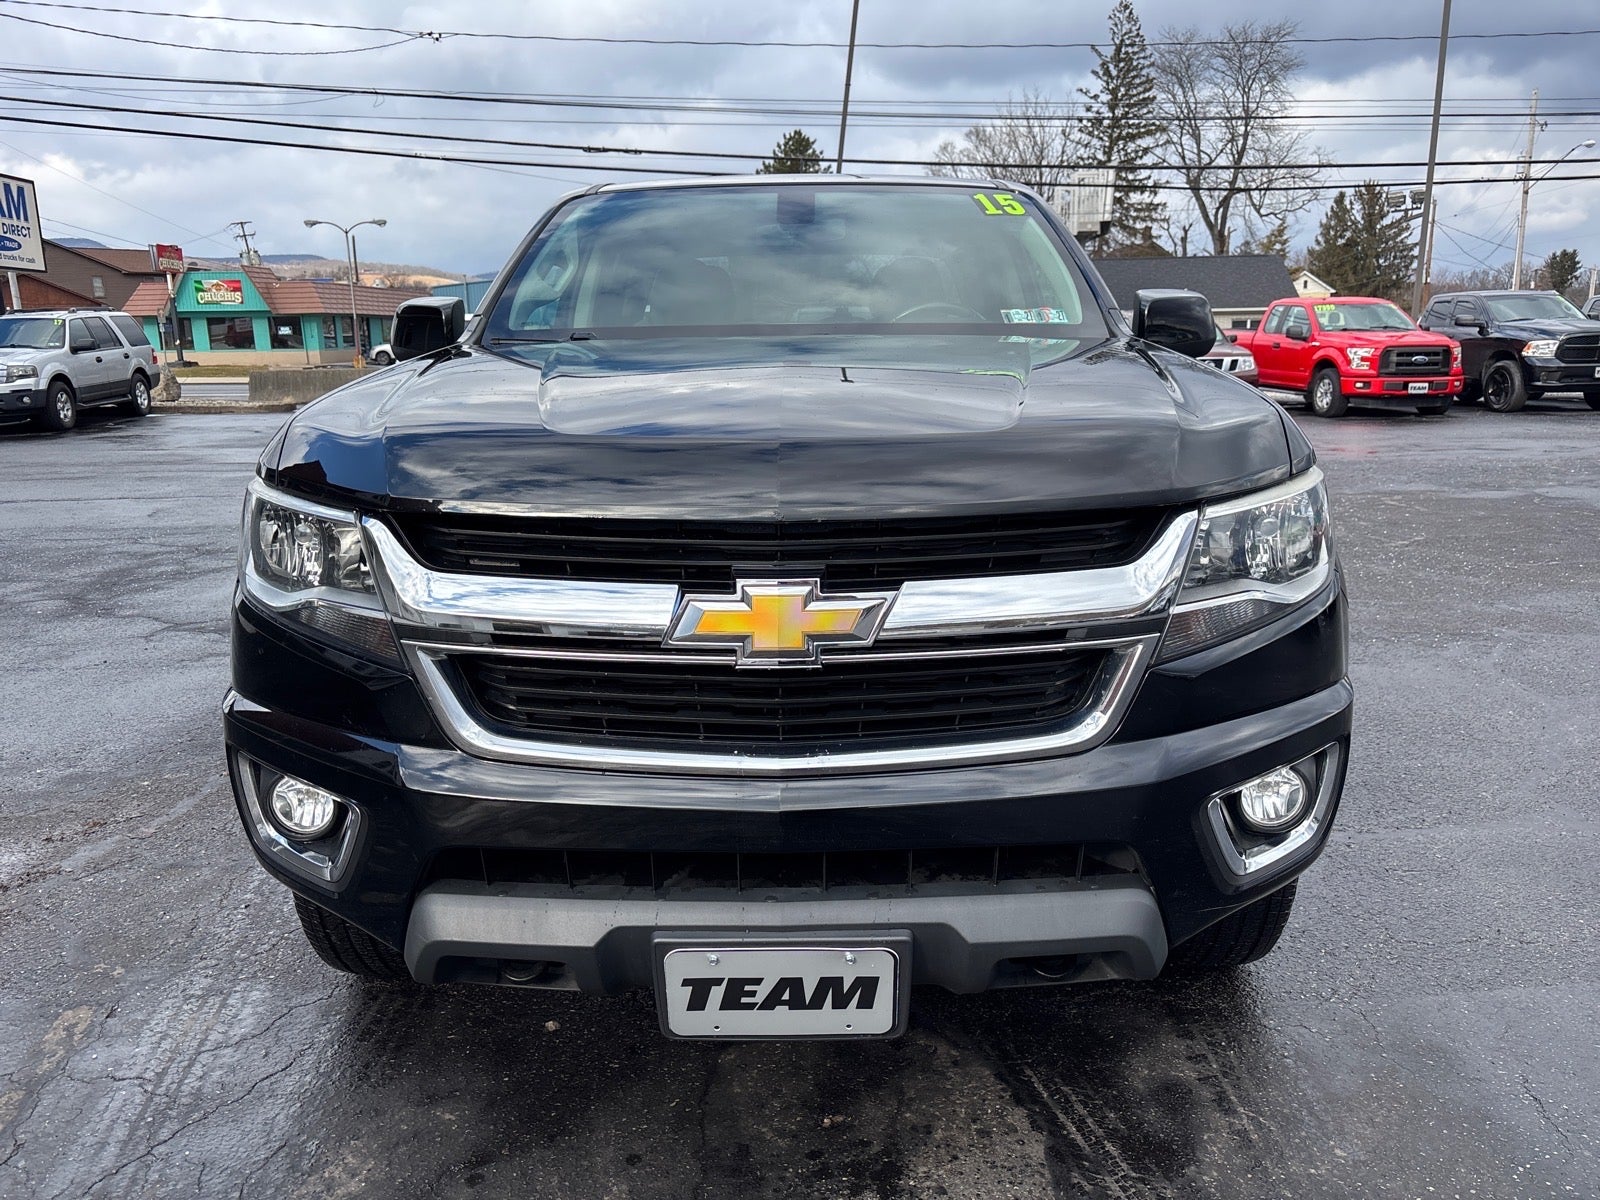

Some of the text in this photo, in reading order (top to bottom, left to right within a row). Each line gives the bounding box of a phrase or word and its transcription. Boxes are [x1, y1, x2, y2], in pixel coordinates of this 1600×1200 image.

[973, 193, 1026, 215] 15
[2, 222, 31, 238] DIRECT
[197, 291, 242, 304] CHUCHIS
[1055, 310, 1066, 321] 27
[680, 975, 881, 1012] TEAM
